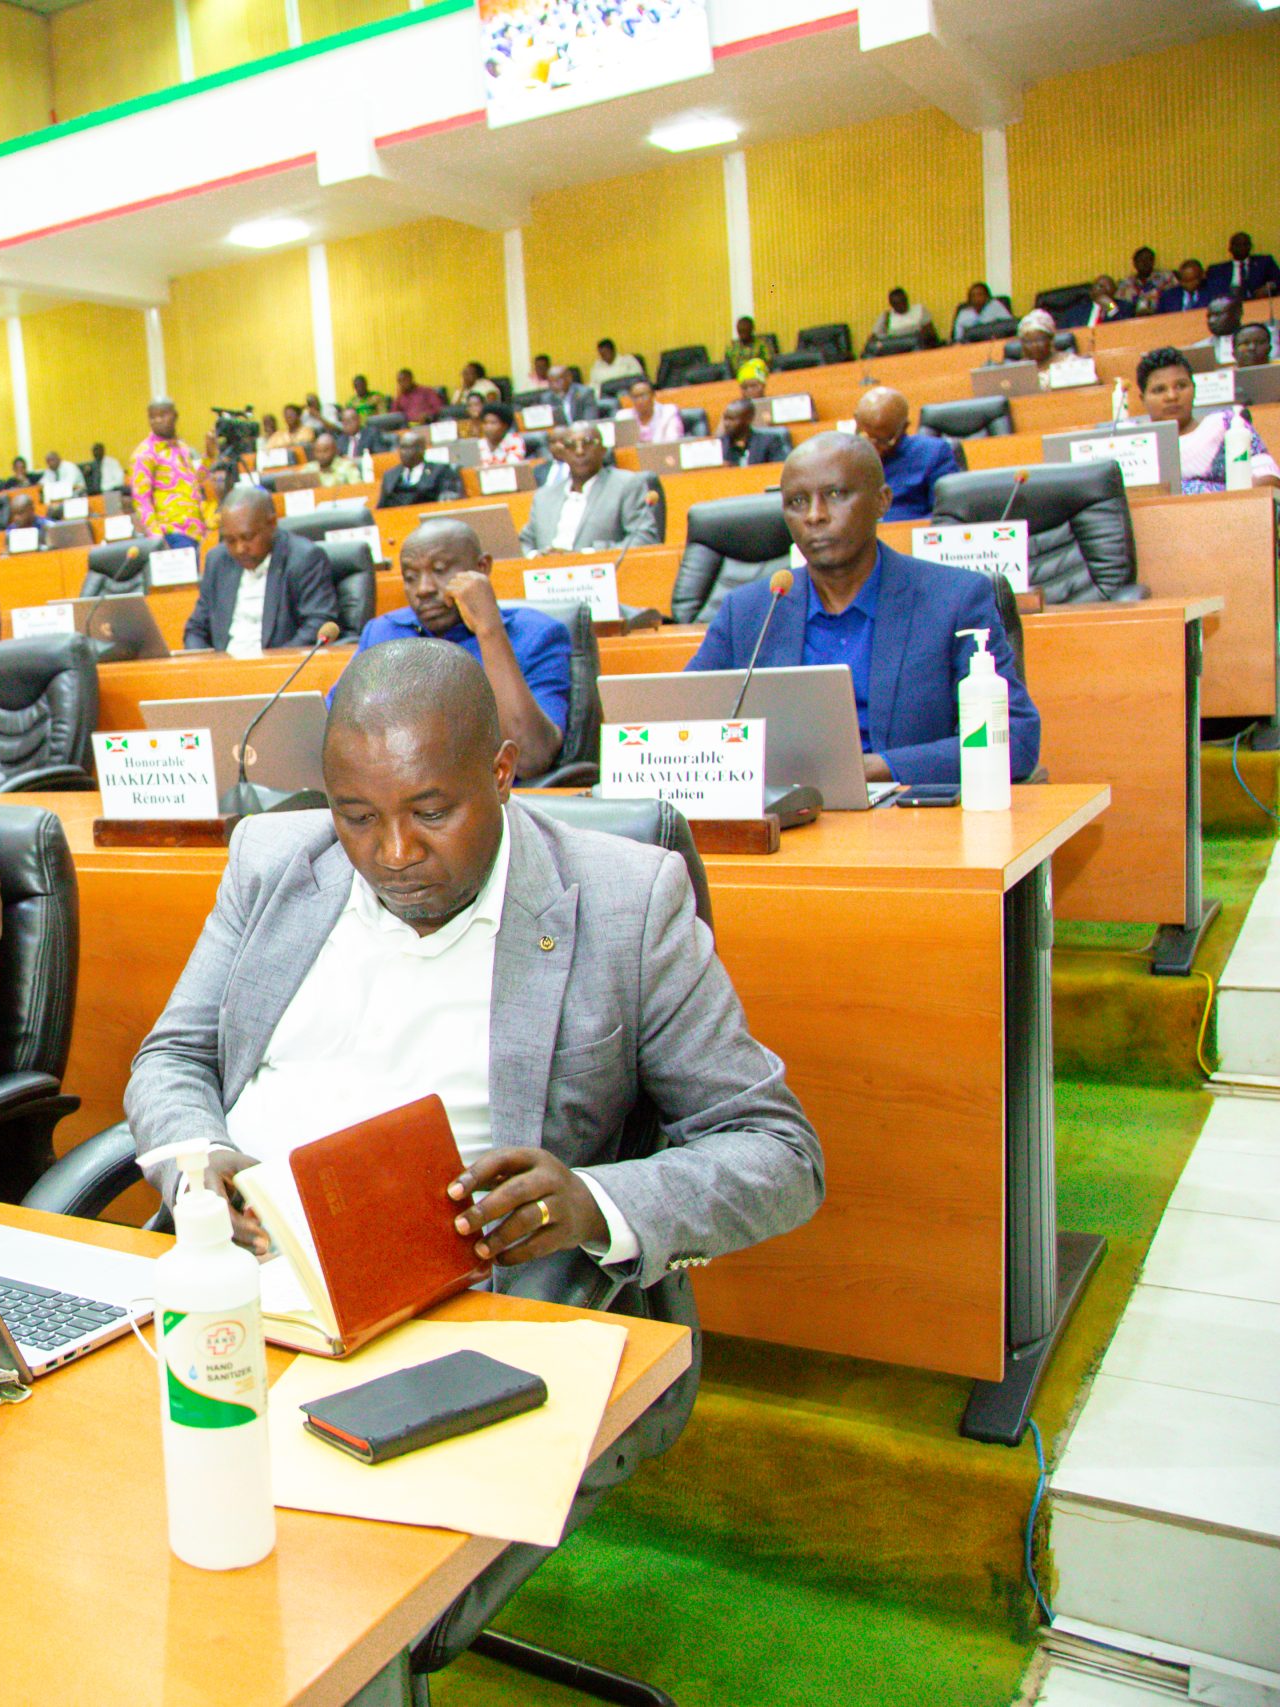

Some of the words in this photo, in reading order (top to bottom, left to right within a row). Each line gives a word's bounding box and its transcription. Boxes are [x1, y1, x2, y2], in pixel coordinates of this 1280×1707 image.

[939, 550, 1000, 561] Honorable
[124, 756, 186, 768] Honorable
[639, 751, 725, 765] Honorable
[105, 772, 209, 786] HAKIZIMANA
[612, 769, 754, 783] HARAMATEGEKO
[658, 788, 705, 800] Fabien
[206, 1362, 233, 1372] HAND
[207, 1366, 252, 1382] SANITIZER
